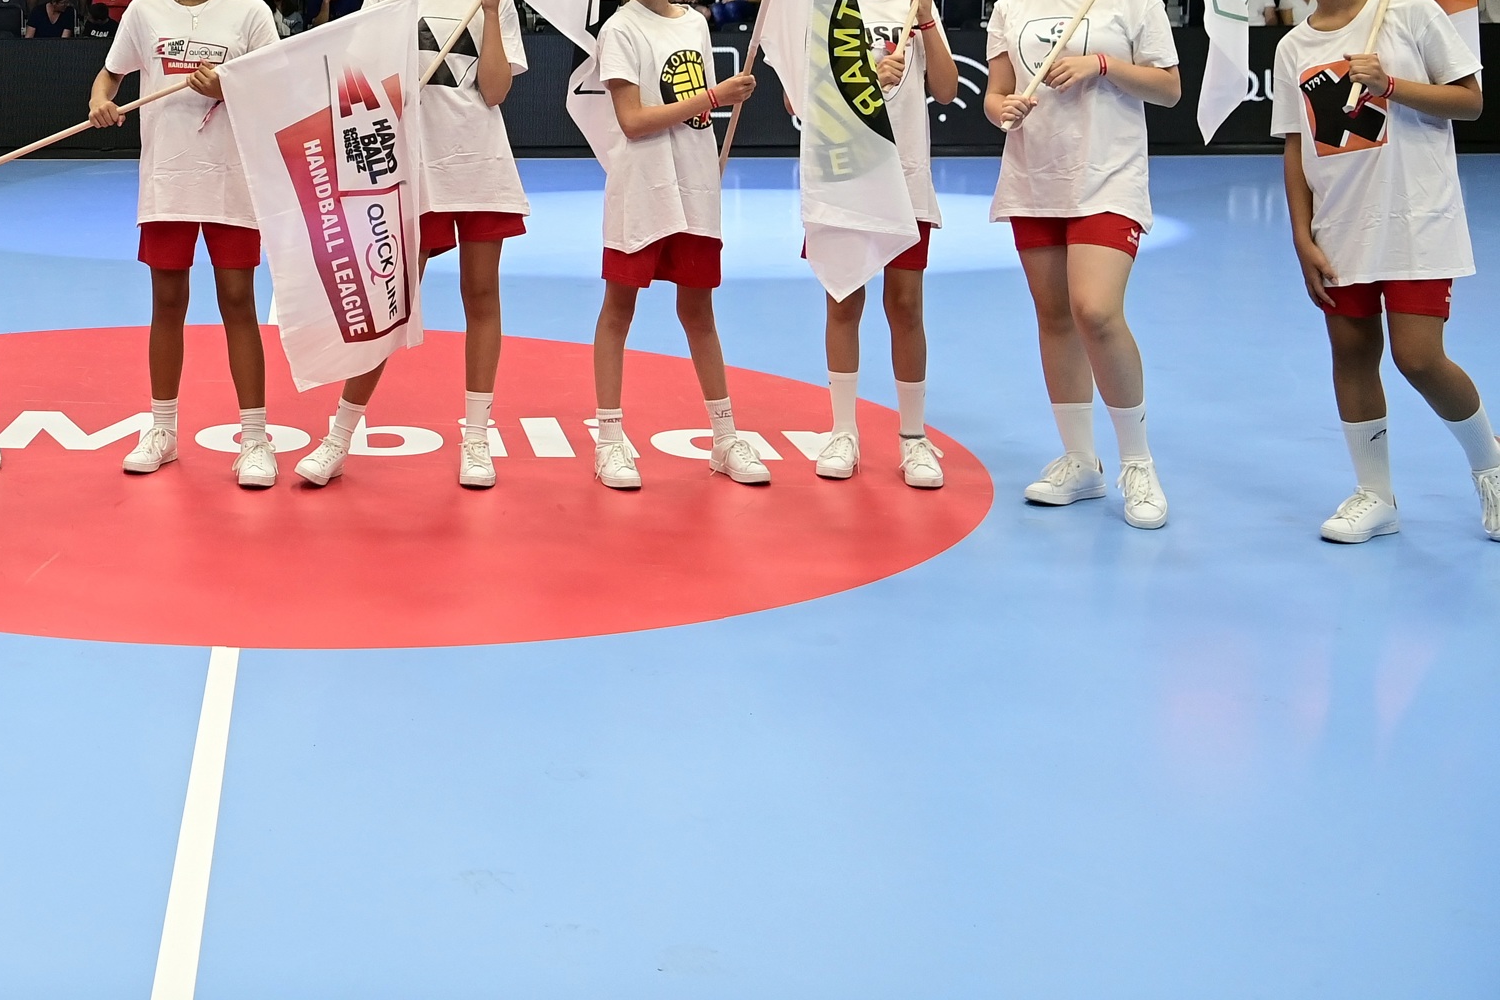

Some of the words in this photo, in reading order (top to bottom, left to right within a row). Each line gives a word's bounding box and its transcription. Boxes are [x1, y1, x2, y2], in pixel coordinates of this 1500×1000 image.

[167, 61, 199, 69] HANDBALL
[1304, 73, 1327, 92] 1791
[342, 128, 356, 163] SUISSE
[349, 126, 367, 174] SCHWEIZ
[359, 132, 389, 185] BALL
[372, 117, 399, 175] HAND
[303, 138, 341, 254] HANDBALL
[331, 256, 369, 337] LEAGUE
